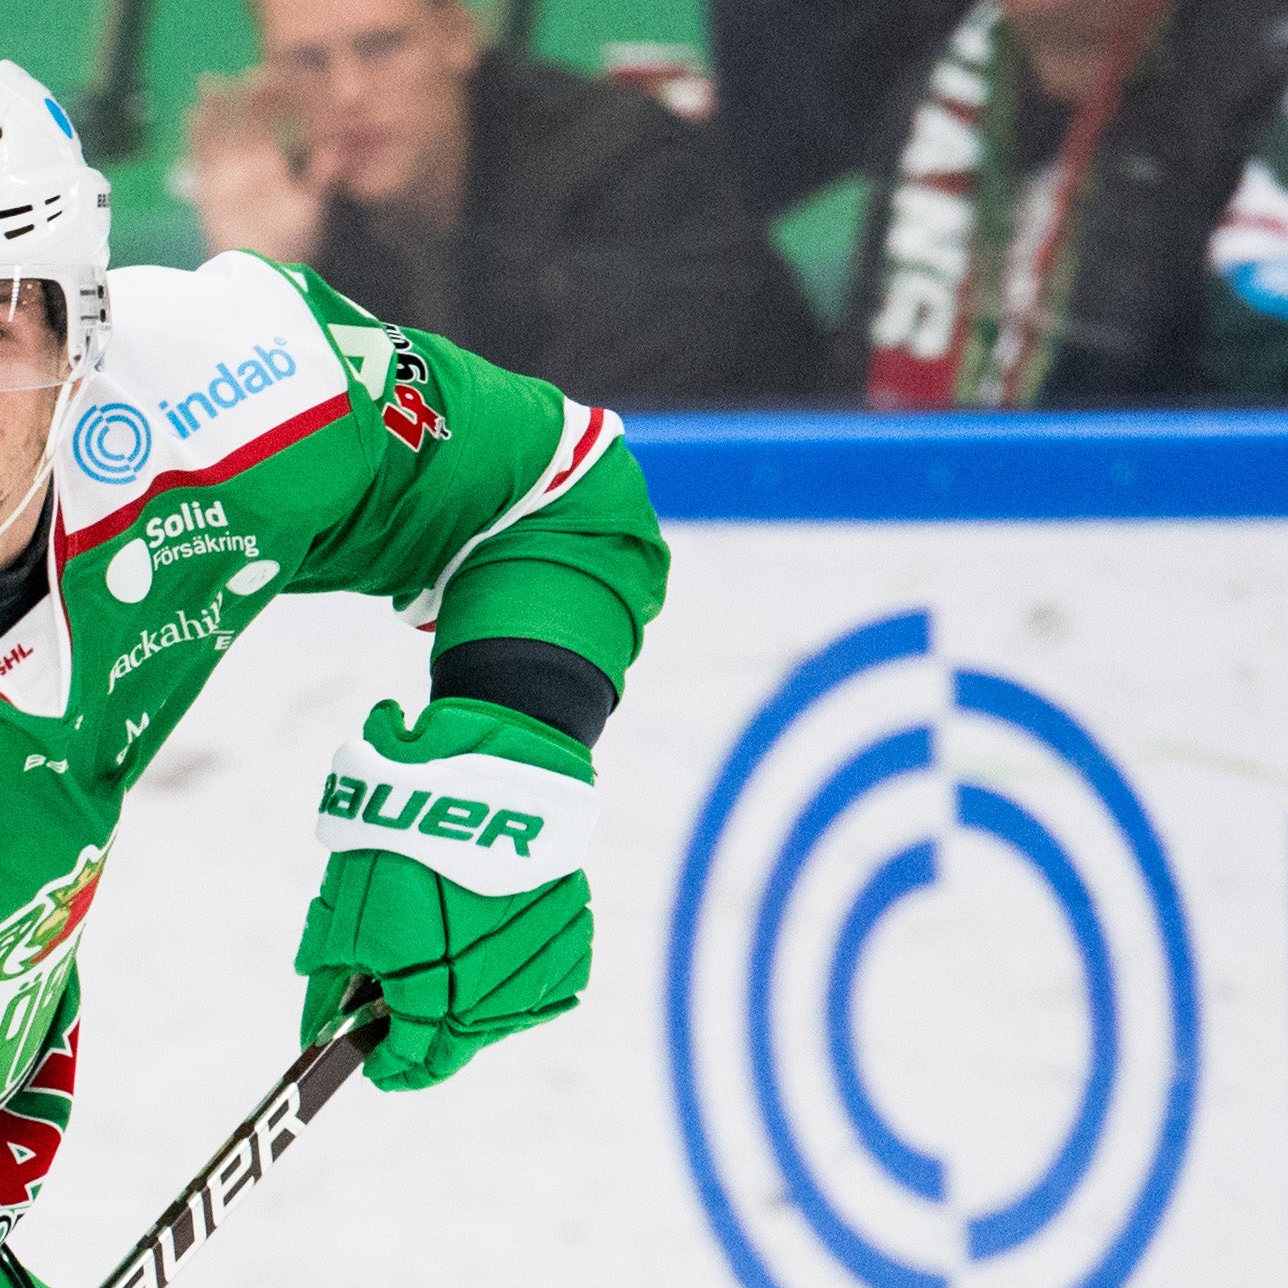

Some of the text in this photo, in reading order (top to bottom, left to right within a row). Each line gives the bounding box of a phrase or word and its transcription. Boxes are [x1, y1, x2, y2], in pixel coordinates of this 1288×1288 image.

[158, 345, 297, 440] indab
[146, 500, 229, 548] Solid
[152, 531, 260, 571] Försäkring
